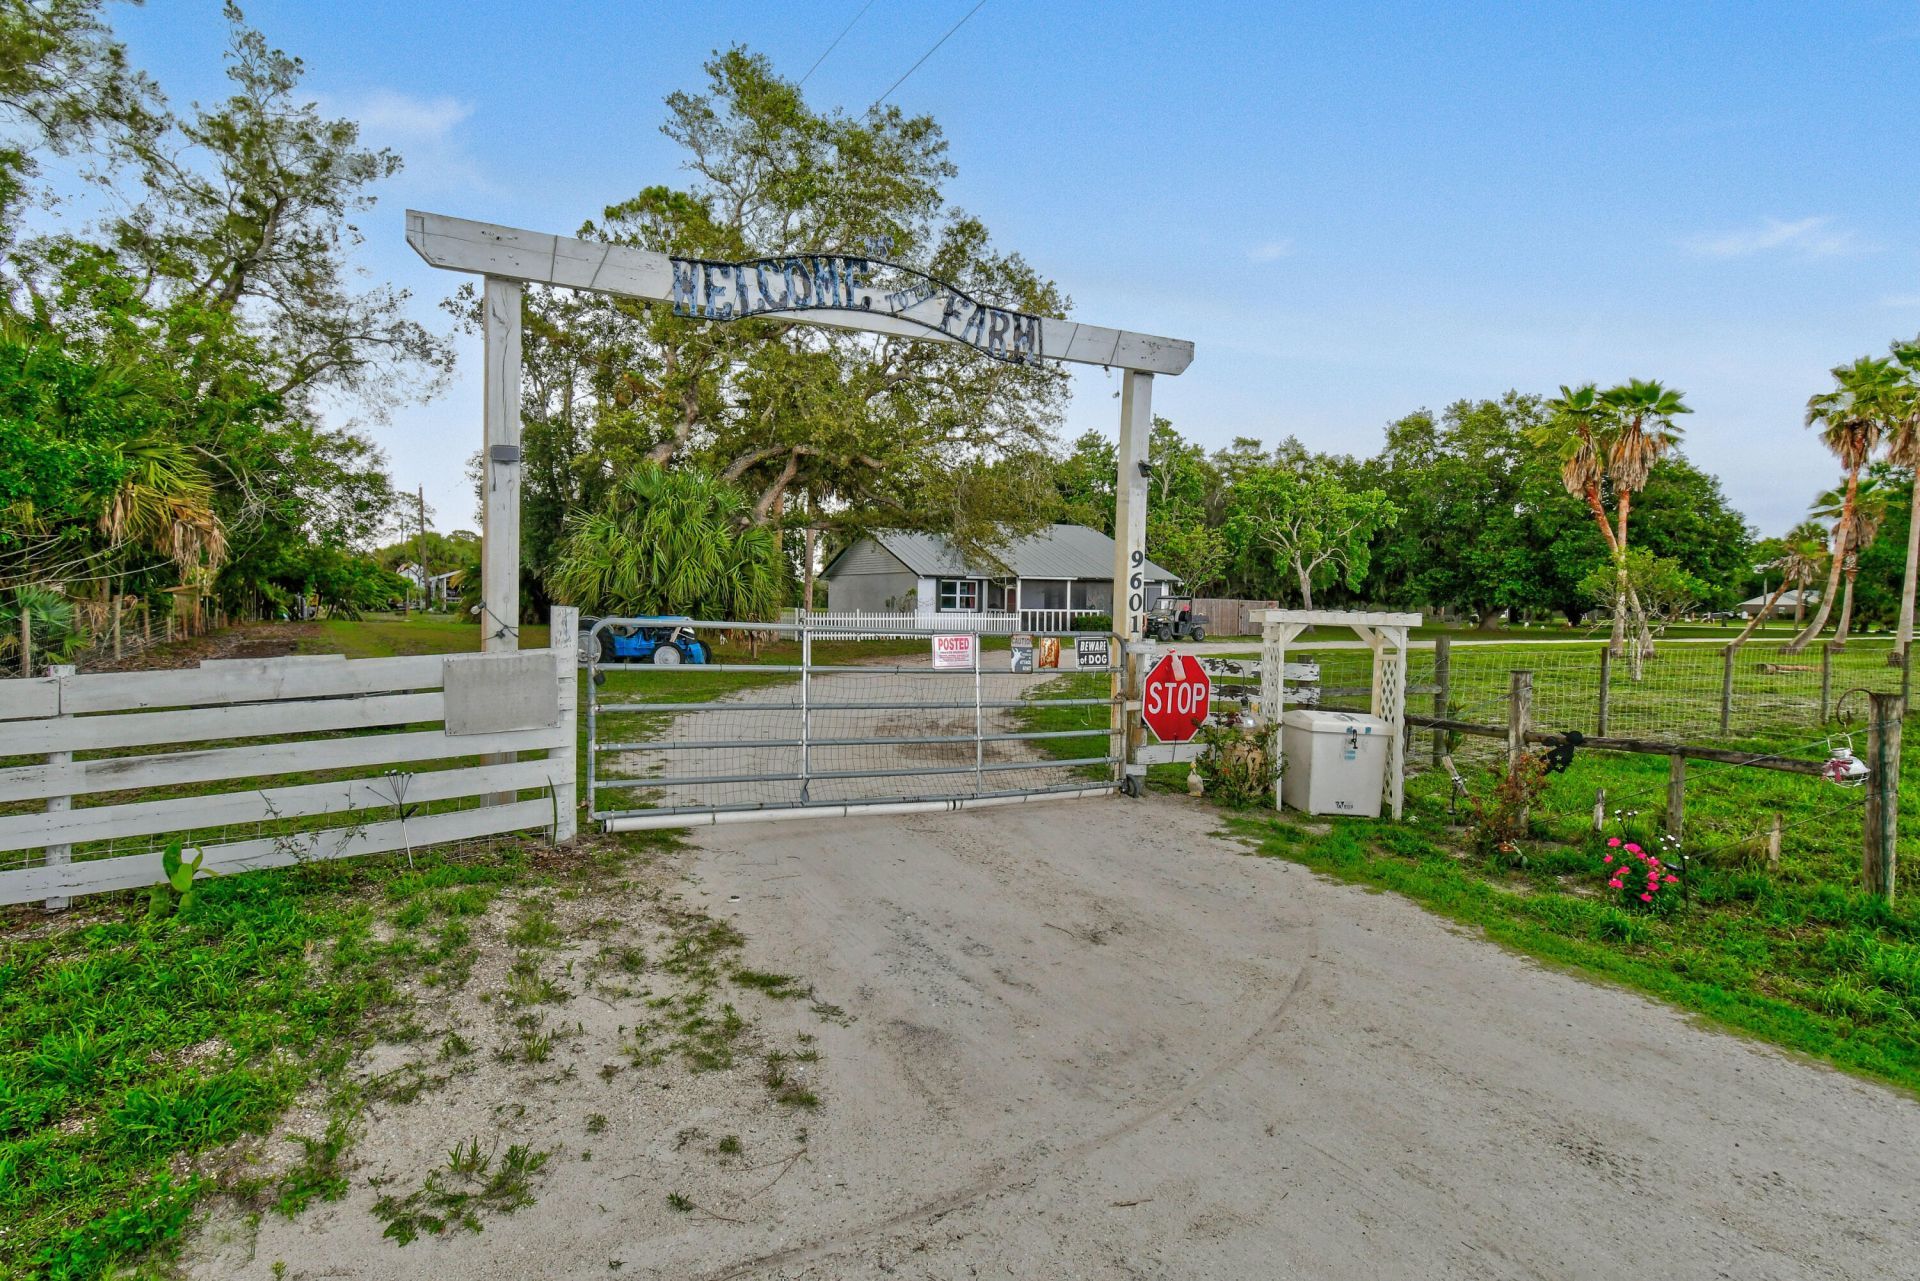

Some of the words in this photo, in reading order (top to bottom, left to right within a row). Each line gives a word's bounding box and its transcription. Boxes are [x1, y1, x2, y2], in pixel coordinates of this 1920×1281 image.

[670, 257, 872, 318] WELCOME
[939, 294, 1036, 362] FARM
[1129, 550, 1144, 633] 9601
[938, 637, 969, 650] POSTED
[1080, 641, 1107, 651] BEWARE
[1080, 655, 1088, 664] of
[1088, 654, 1108, 665] DOG
[1147, 681, 1206, 714] STOP
